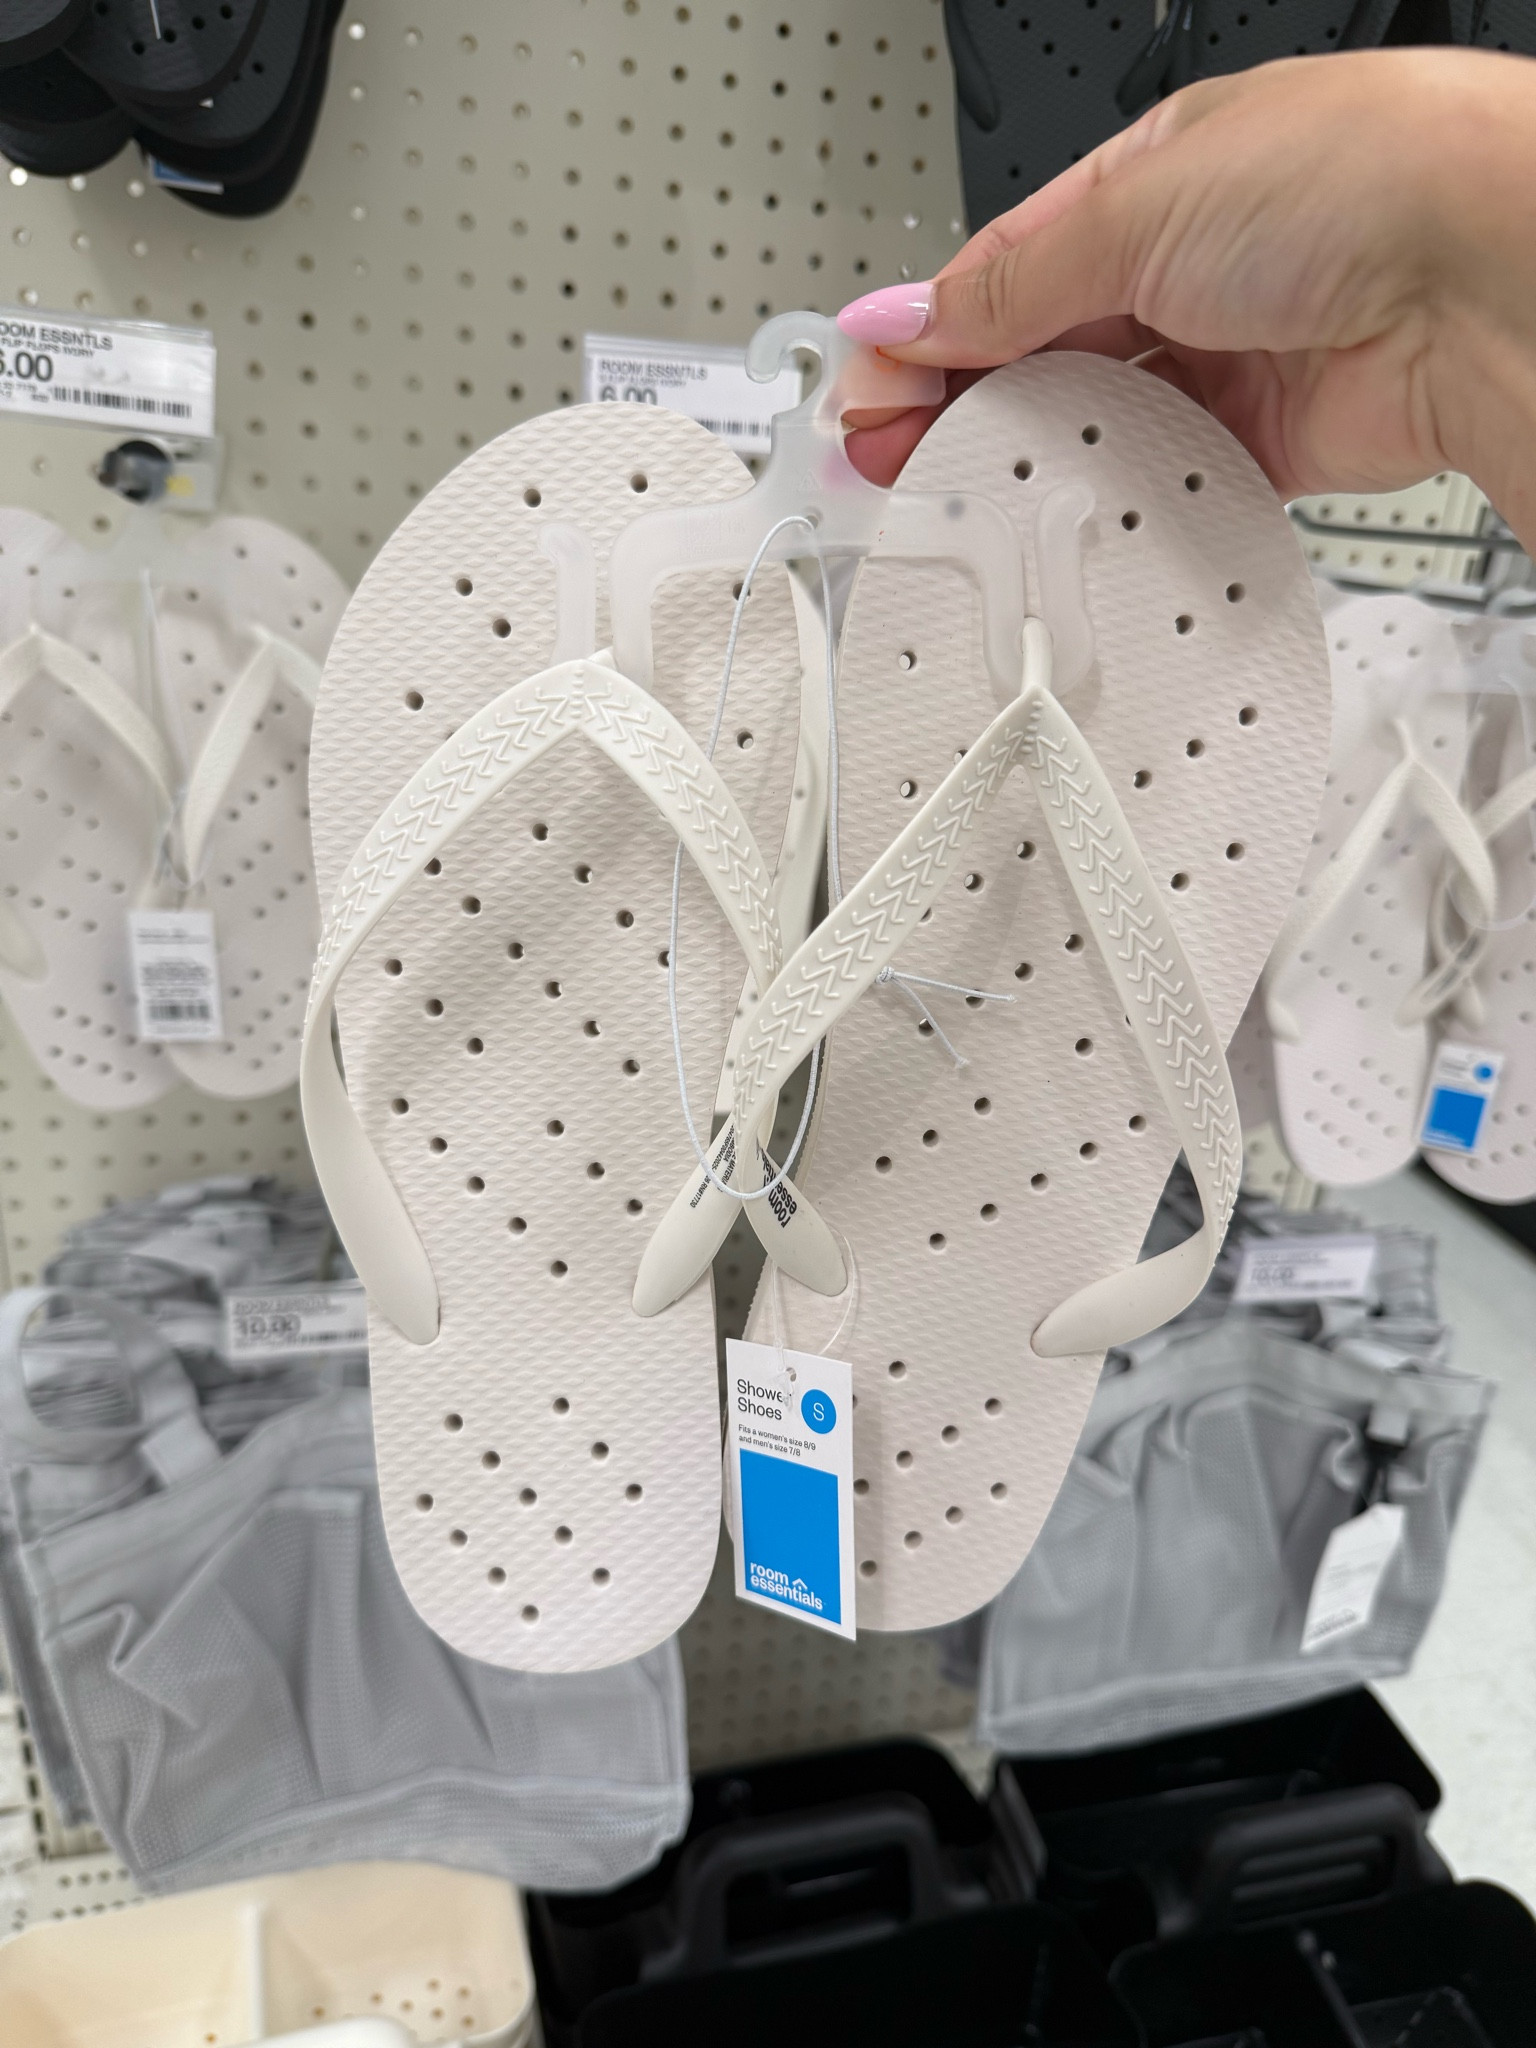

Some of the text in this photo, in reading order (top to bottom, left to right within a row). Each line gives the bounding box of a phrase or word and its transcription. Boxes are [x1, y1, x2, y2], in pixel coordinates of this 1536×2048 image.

[40, 328, 113, 351] ESSNTLS
[601, 358, 643, 376] ROOM
[646, 361, 708, 381] ESSNTLS
[737, 1379, 784, 1403] Showe
[738, 1397, 782, 1421] Shoes
[813, 1403, 824, 1421] S
[738, 1424, 816, 1451] Fits a women's size 8/9
[738, 1434, 801, 1457] and men's size 7/8
[750, 1562, 789, 1586] room
[750, 1575, 823, 1610] essentials
